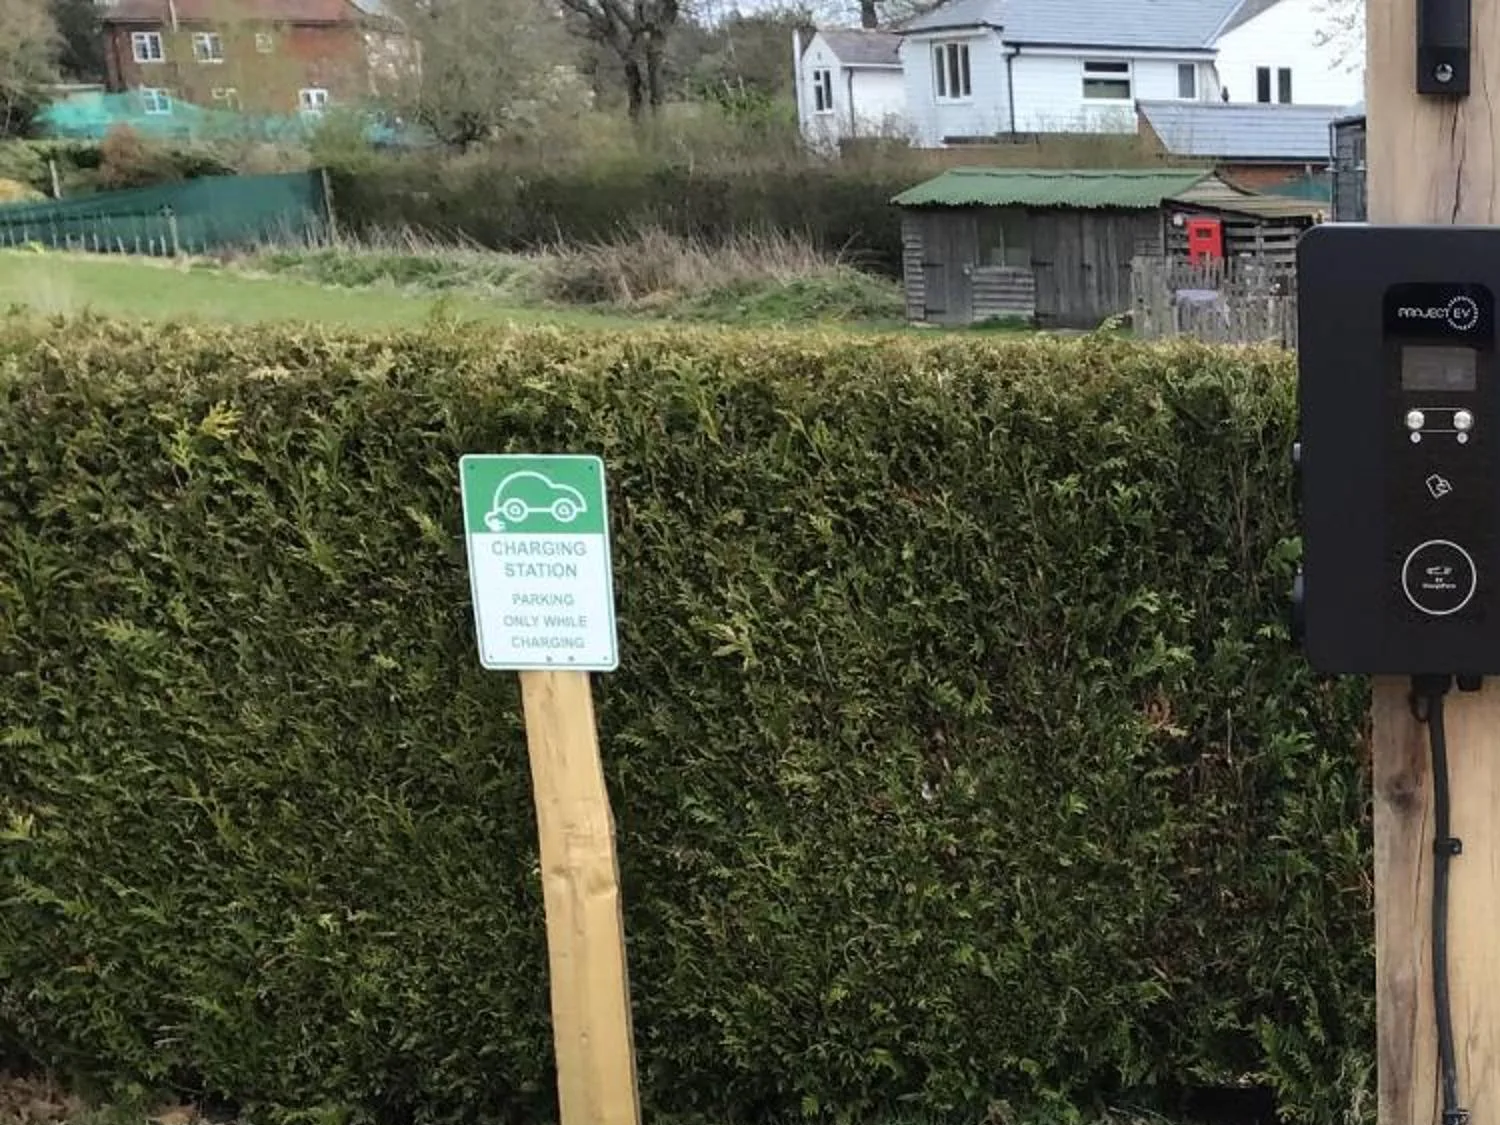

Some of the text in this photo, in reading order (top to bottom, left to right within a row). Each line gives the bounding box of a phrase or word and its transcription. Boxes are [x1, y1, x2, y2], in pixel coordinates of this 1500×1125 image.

[1398, 307, 1471, 318] PROJECT EV
[491, 540, 587, 556] CHARGING
[504, 563, 577, 578] STATION
[512, 593, 575, 606] PARKING
[503, 615, 587, 628] ONLY WHILE
[511, 636, 585, 649] CHARGING
